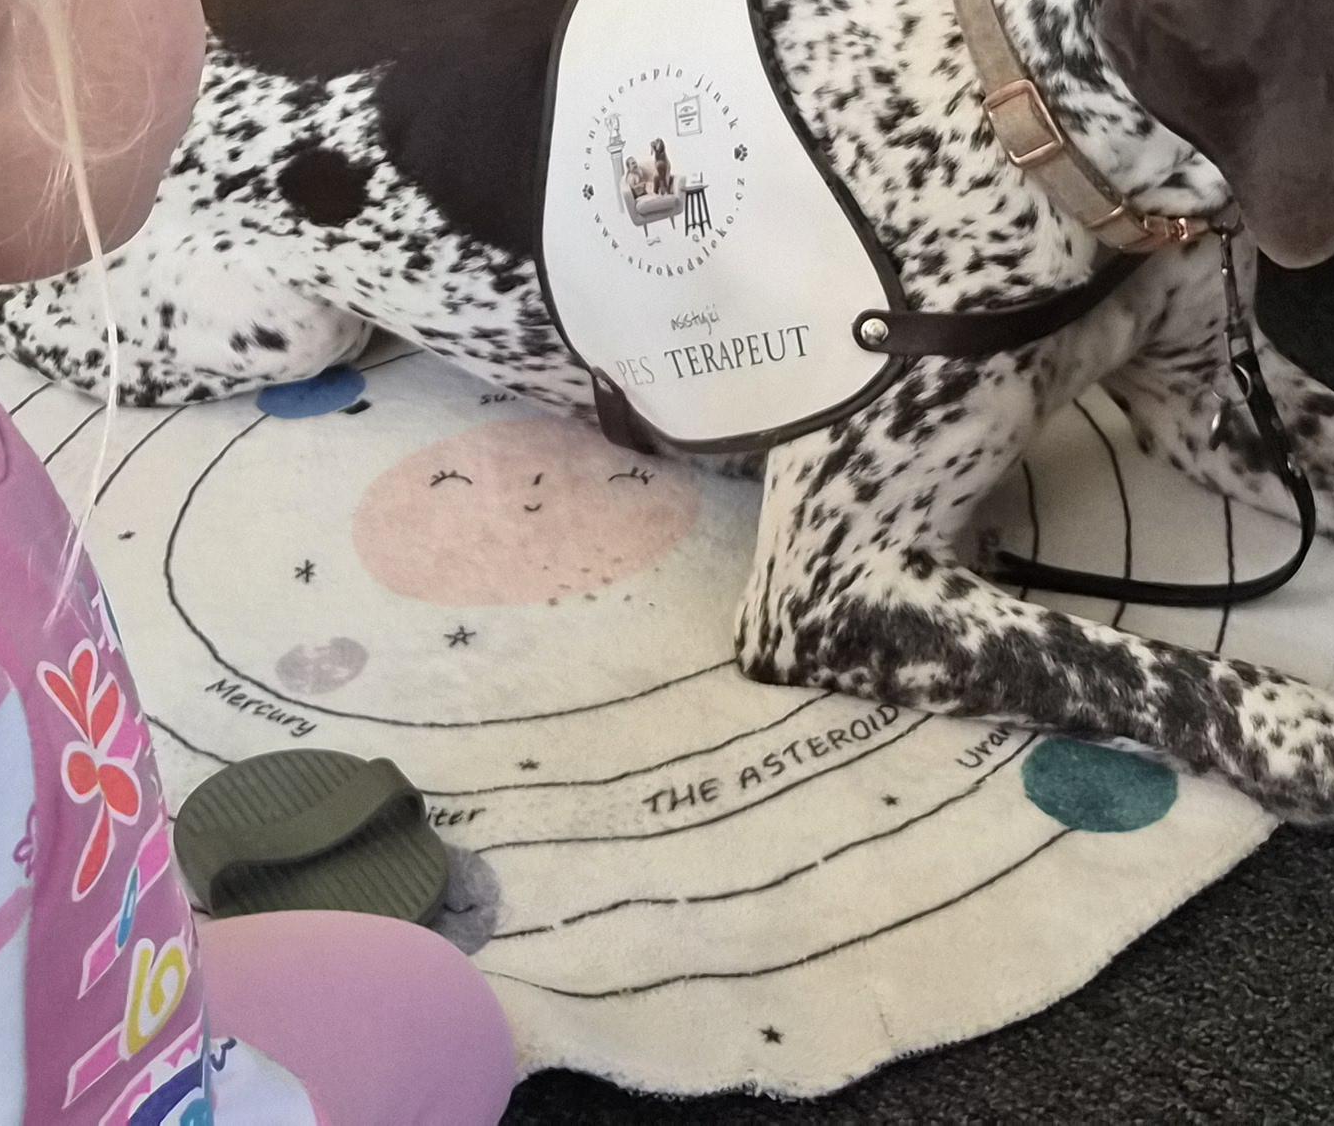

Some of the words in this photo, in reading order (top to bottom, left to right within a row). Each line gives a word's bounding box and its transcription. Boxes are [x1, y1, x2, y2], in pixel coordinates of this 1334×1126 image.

[617, 355, 656, 387] PES
[664, 325, 810, 379] TERAPEUT
[205, 678, 318, 737] Mercury
[641, 778, 721, 815] THE
[740, 703, 900, 790] ASTEROID
[427, 805, 487, 827] iter
